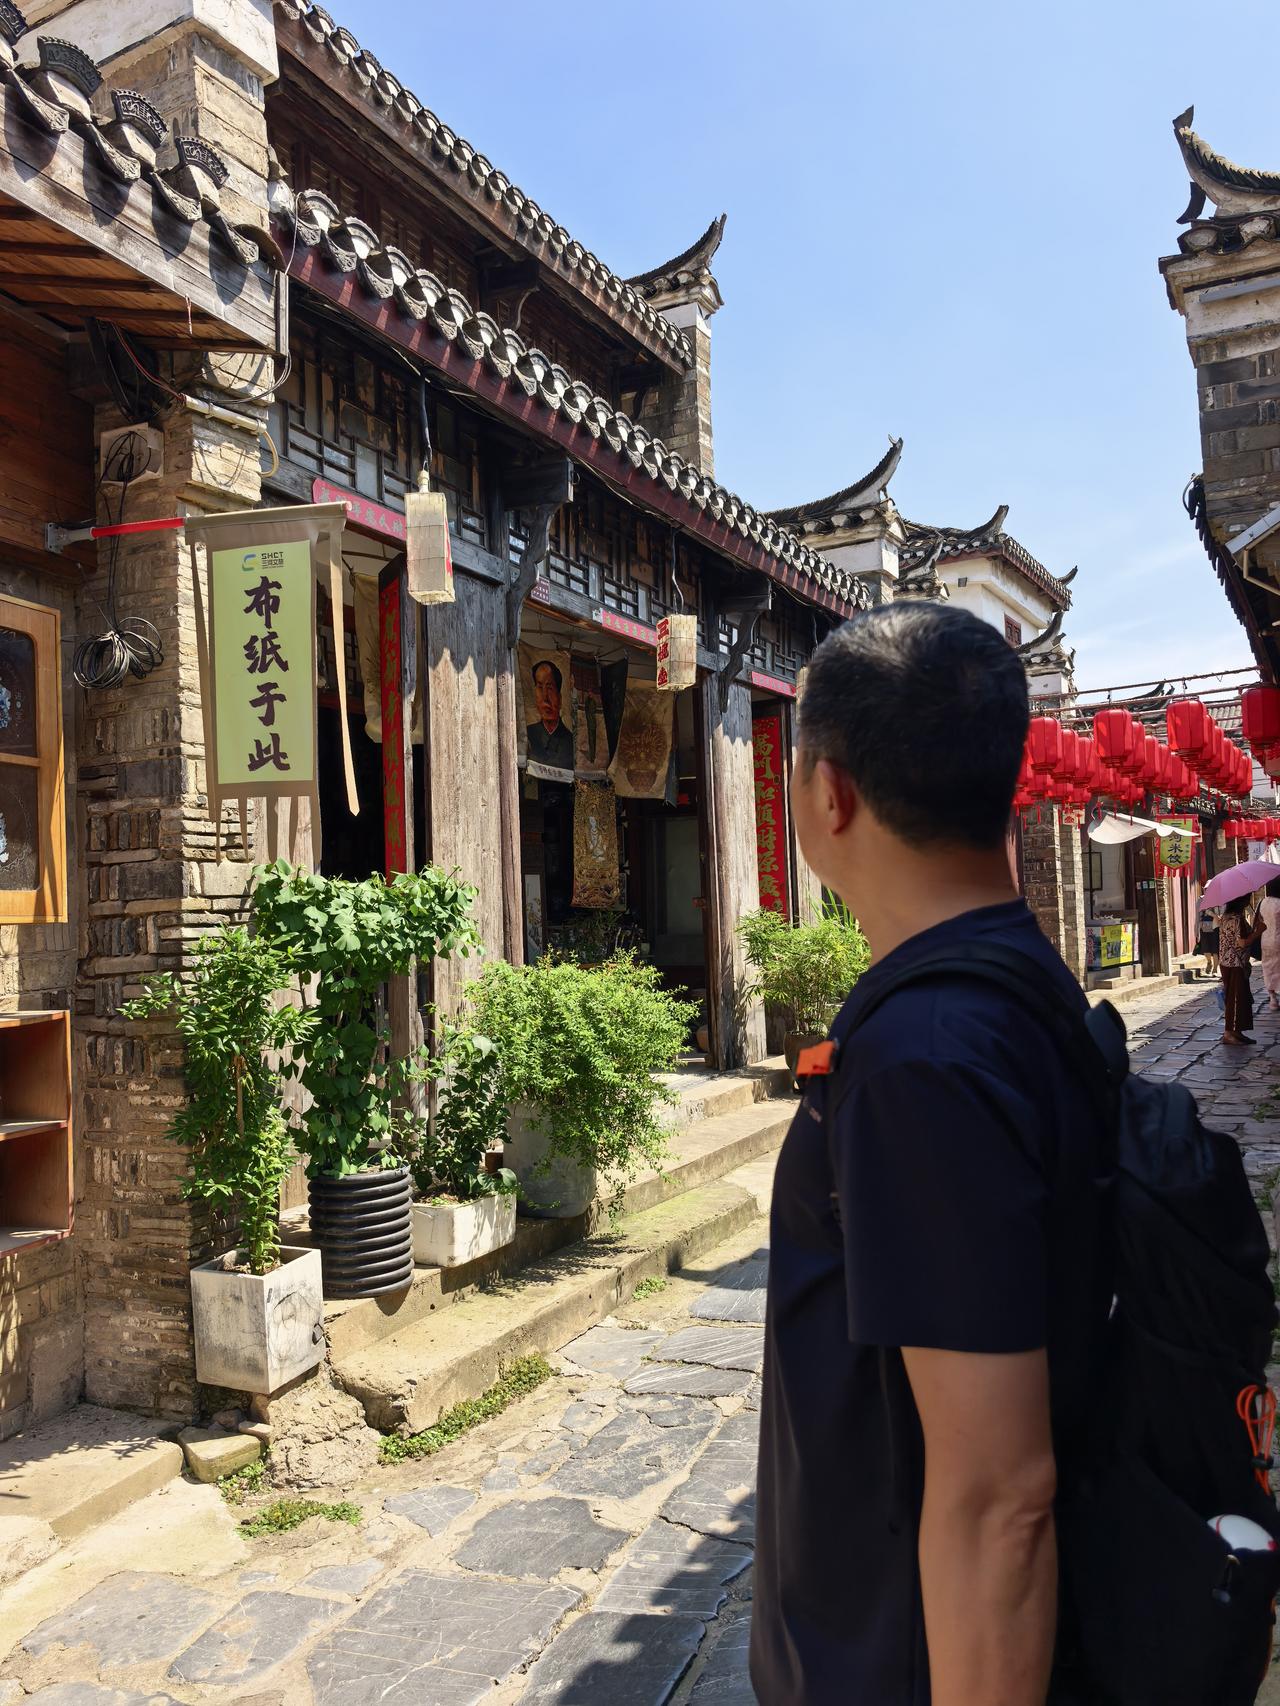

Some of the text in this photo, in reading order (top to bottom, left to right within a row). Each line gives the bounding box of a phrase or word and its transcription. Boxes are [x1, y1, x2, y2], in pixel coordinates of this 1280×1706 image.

[261, 551, 284, 560] SHCT
[242, 576, 290, 772] 布纸于此
